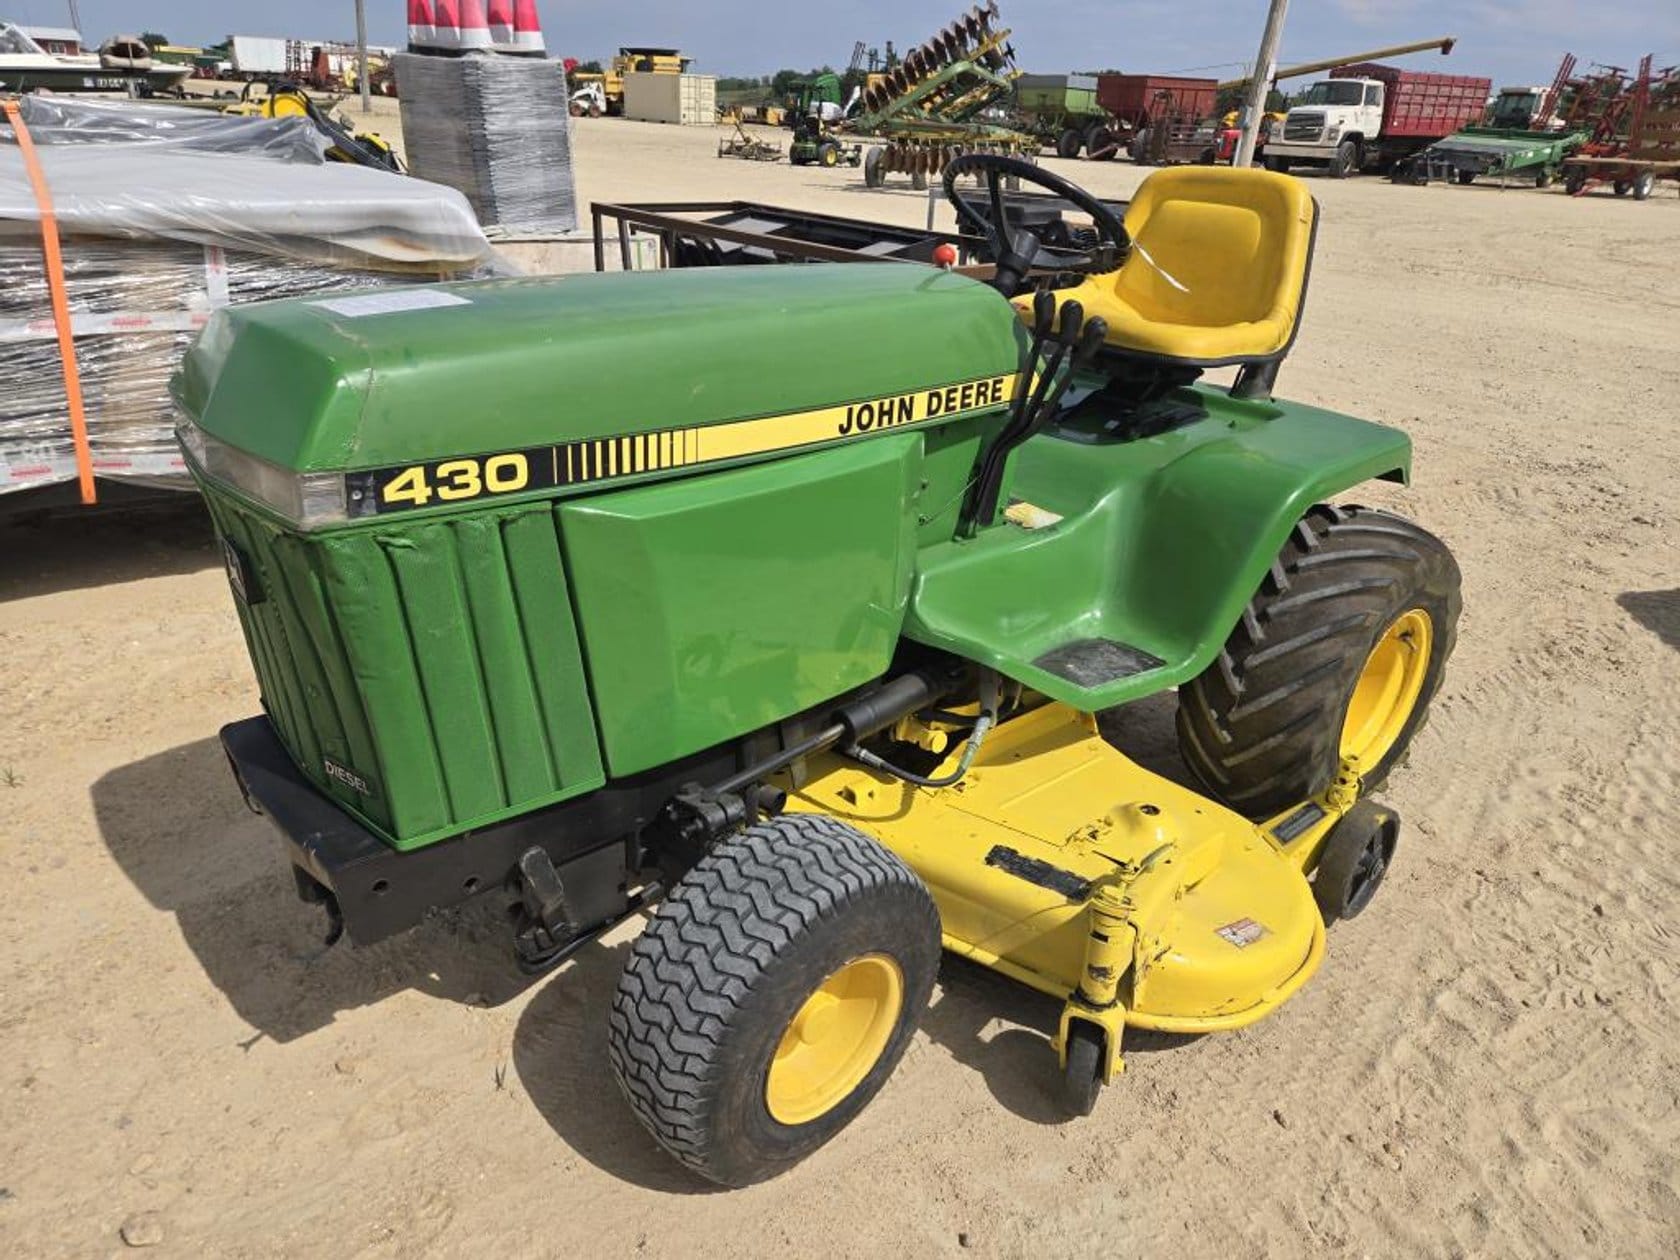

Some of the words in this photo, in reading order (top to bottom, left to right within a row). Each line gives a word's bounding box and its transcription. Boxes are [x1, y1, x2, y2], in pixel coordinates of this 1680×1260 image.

[838, 395, 915, 435] JOHN
[926, 378, 1004, 417] DEERE
[382, 453, 529, 505] 430
[324, 760, 369, 796] DIESEL
